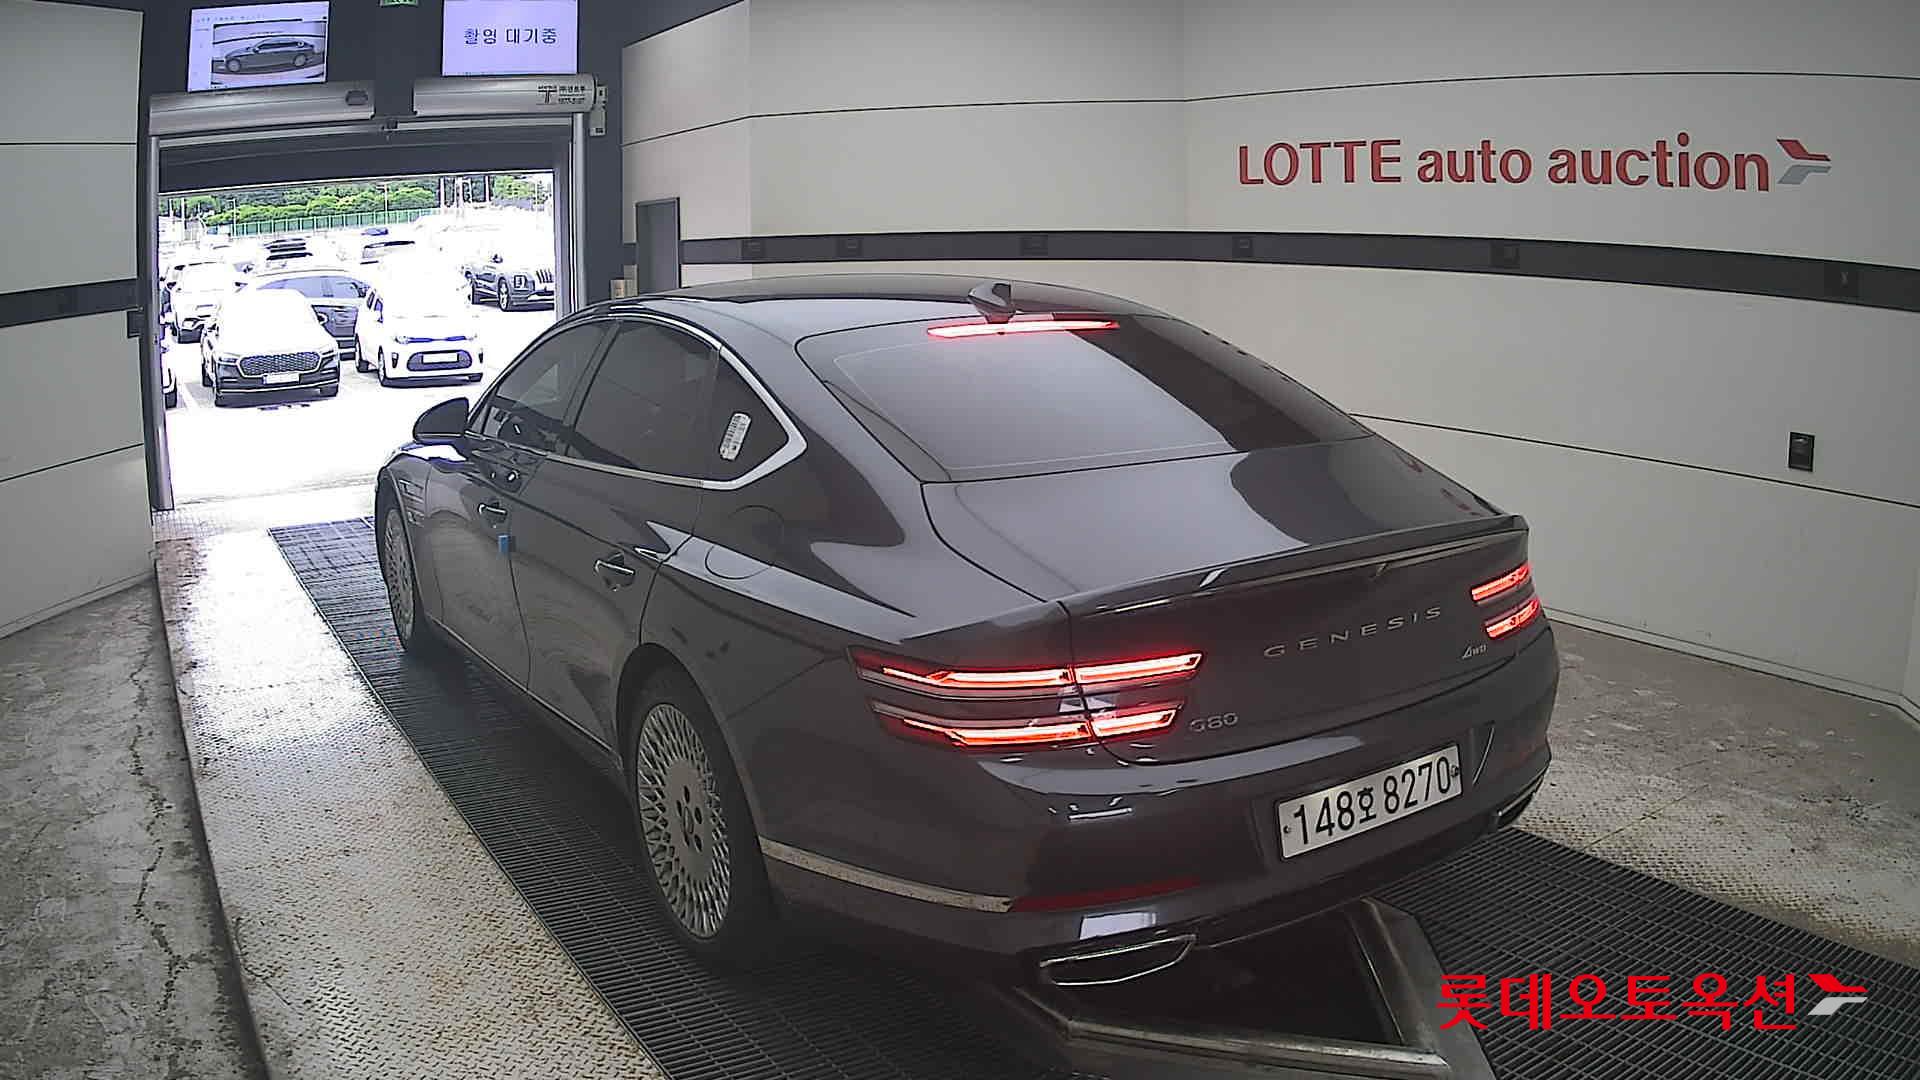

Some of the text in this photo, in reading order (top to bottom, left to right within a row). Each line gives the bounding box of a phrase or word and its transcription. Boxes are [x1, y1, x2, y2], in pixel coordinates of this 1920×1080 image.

[506, 28, 557, 44] 대기중
[1238, 131, 1769, 192] LOTTE auto auction
[1263, 606, 1442, 658] GENESIS
[1189, 712, 1239, 733] G80
[1293, 756, 1451, 845] 148호 8270
